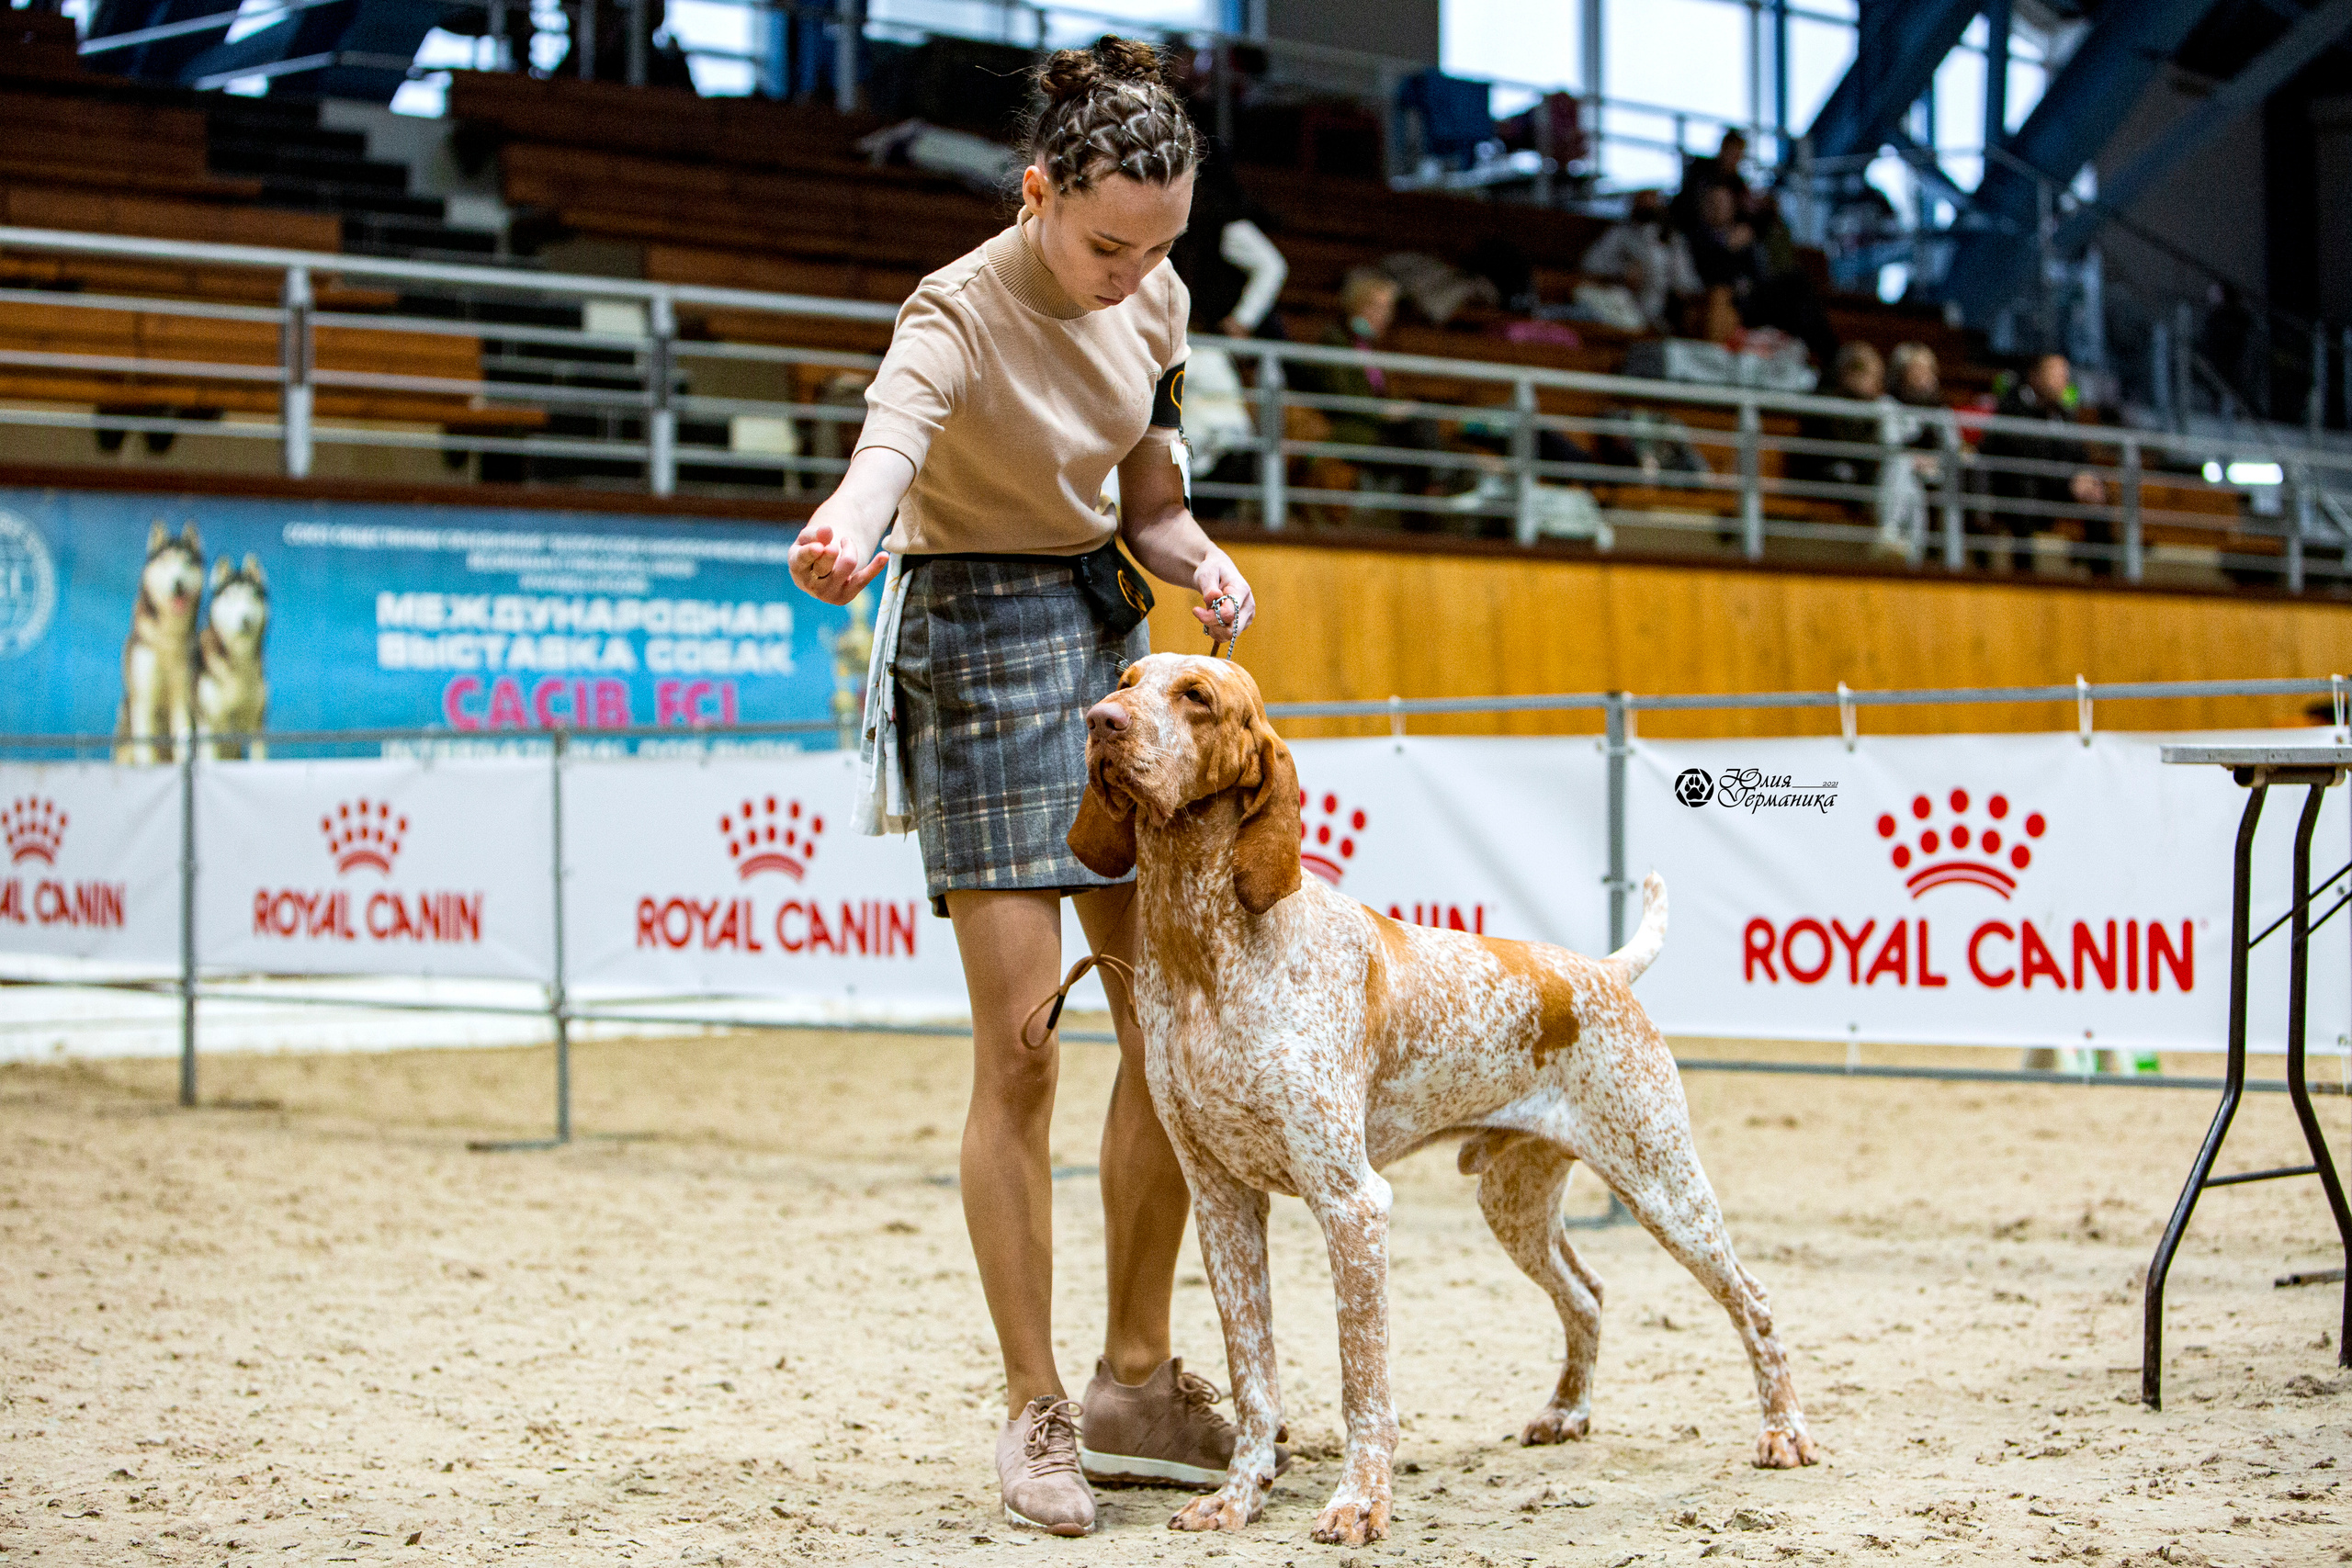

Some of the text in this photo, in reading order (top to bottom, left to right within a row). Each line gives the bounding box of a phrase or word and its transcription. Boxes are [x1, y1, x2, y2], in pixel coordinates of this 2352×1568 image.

[376, 592, 793, 634] МЕЖДУНАРОДНАЯ
[377, 633, 795, 675] ВЫСТАВКА СОБАК
[444, 676, 738, 731] CACIB FCI
[34, 879, 126, 928] CANIN
[254, 889, 482, 943] ROYAL CANIN
[638, 897, 916, 957] ROYAL CANIN
[1745, 918, 2194, 993] ROYAL CANIN
